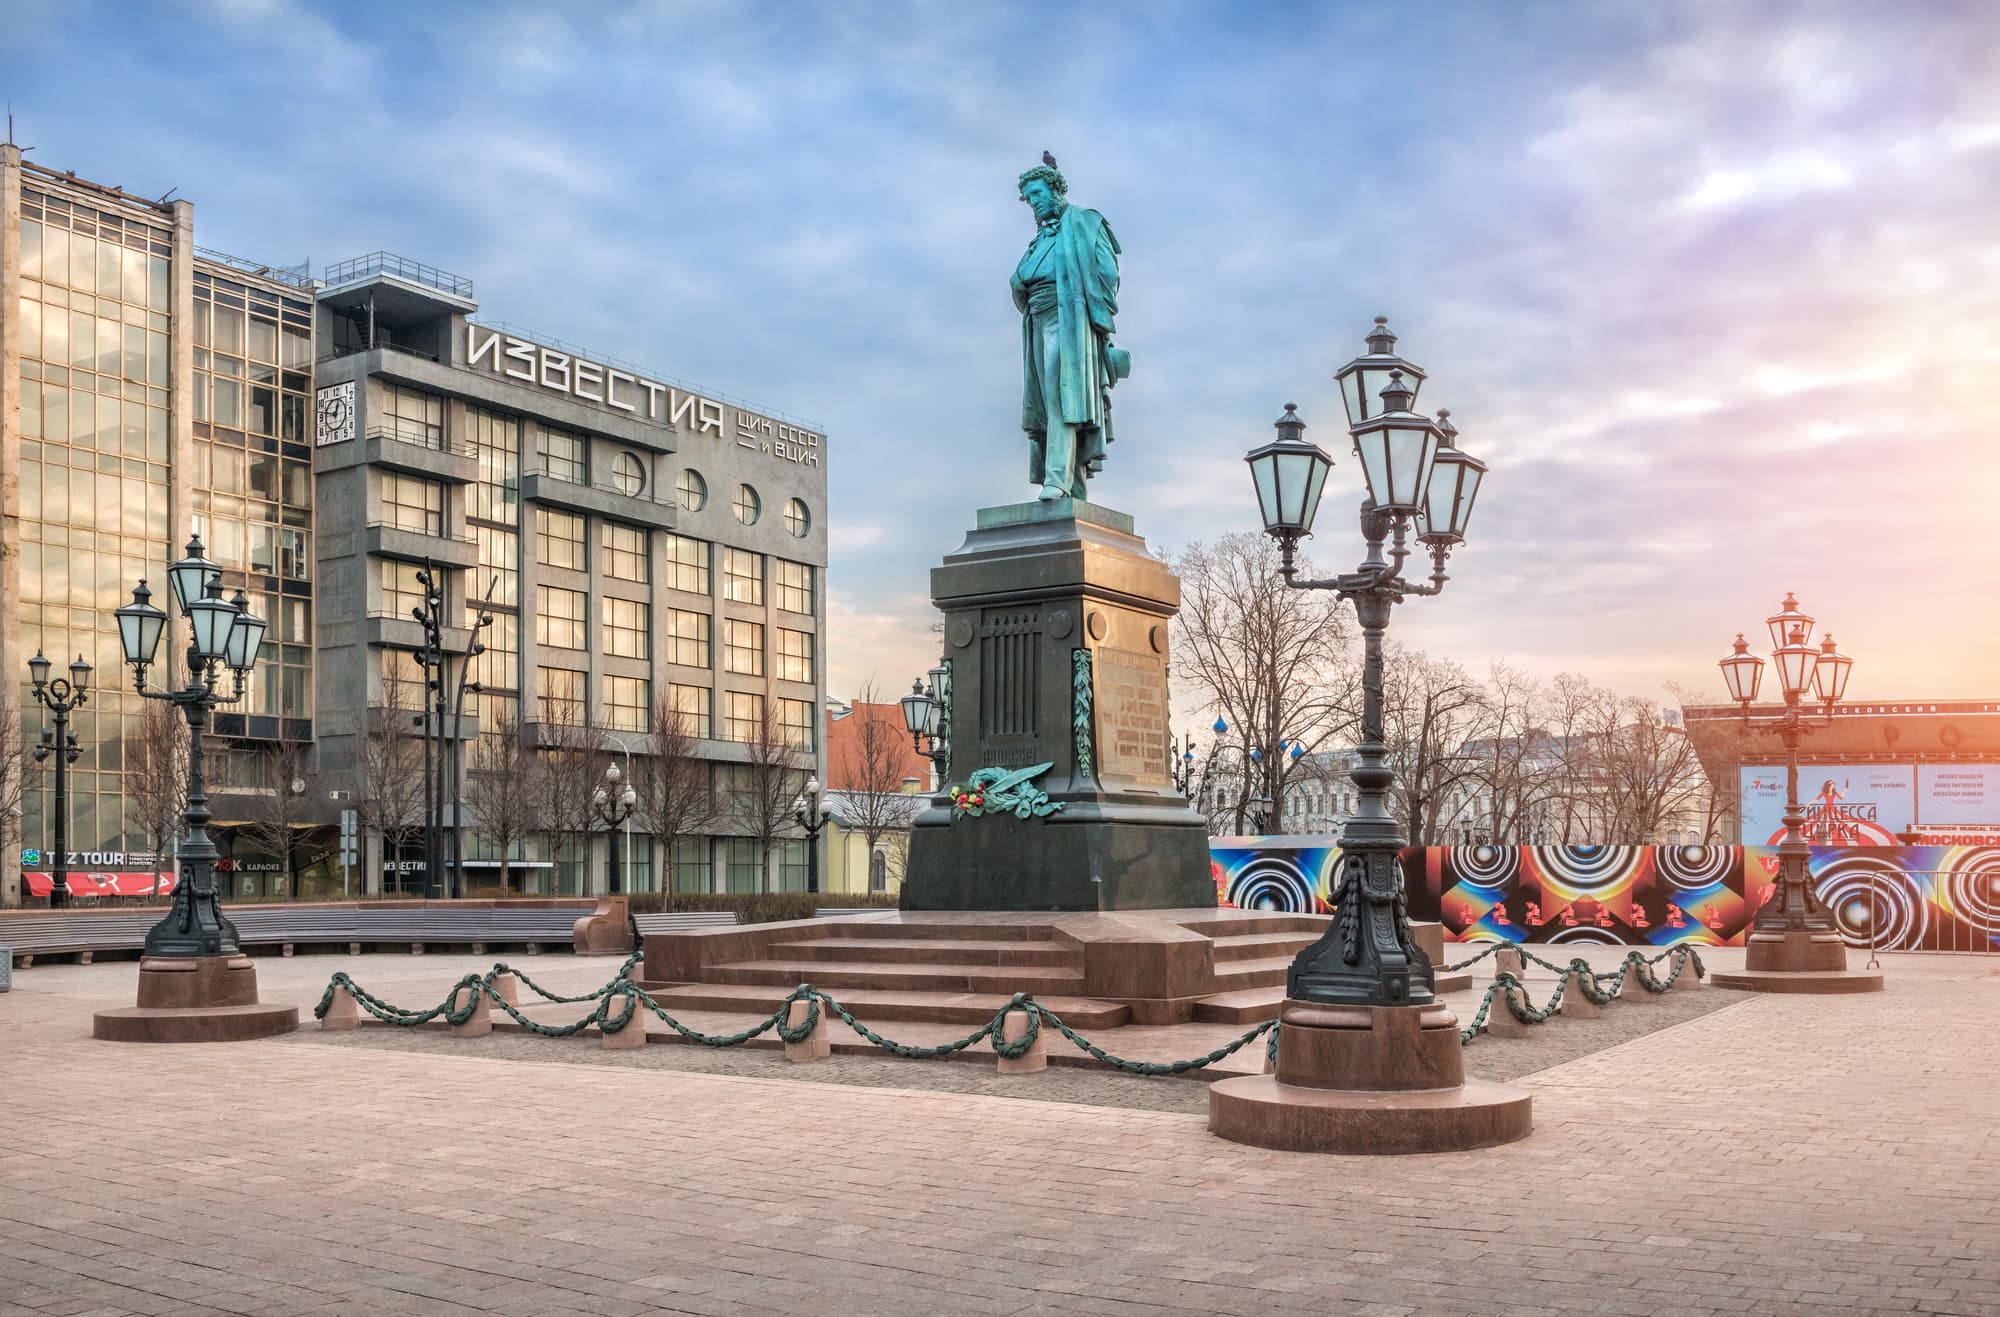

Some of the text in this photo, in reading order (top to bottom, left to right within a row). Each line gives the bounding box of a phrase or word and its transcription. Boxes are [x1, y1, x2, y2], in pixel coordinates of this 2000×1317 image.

[467, 325, 724, 438] ИЗВЕСТИЯ
[737, 411, 818, 447] ЦИК СССР
[775, 441, 818, 467] ВЦИК
[82, 851, 124, 866] TOUR
[246, 863, 280, 871] КАРАОКЕ
